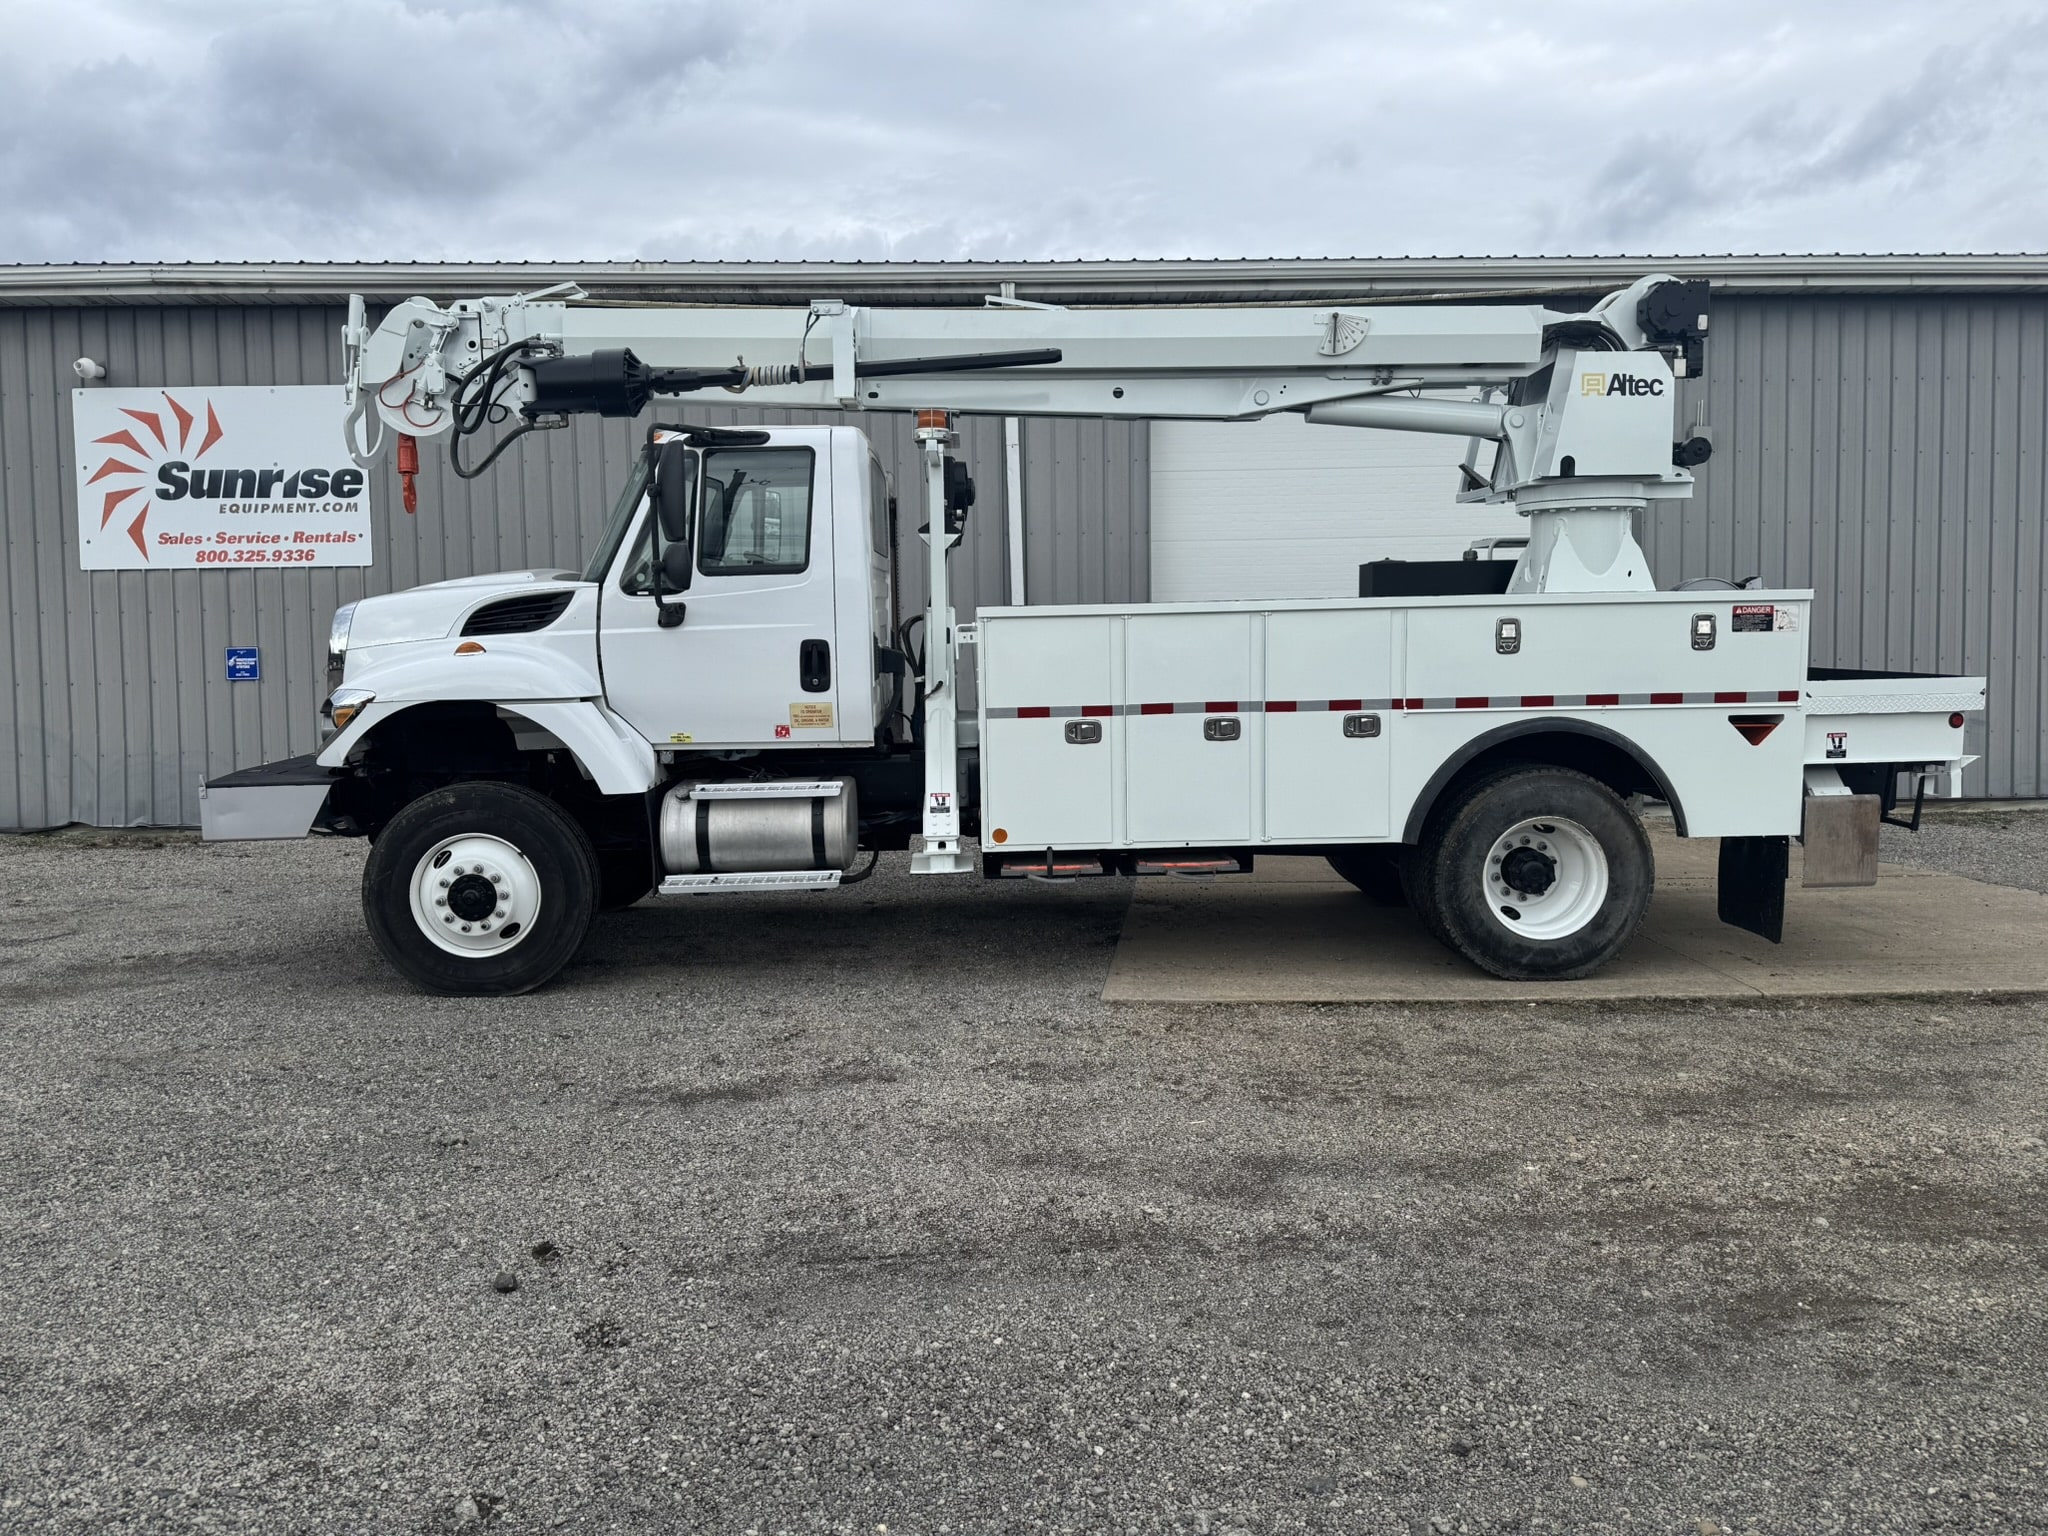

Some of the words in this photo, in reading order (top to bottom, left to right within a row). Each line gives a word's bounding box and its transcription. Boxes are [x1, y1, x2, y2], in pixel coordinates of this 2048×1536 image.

[1606, 373, 1664, 396] Altec
[155, 460, 364, 501] Sunrise
[219, 502, 359, 514] EQUIPMENT.COM
[157, 532, 203, 545] Sales
[215, 531, 281, 544] Service
[292, 530, 356, 543] Rentals
[195, 549, 316, 563] 800.325.9336
[1742, 606, 1771, 614] DANGER
